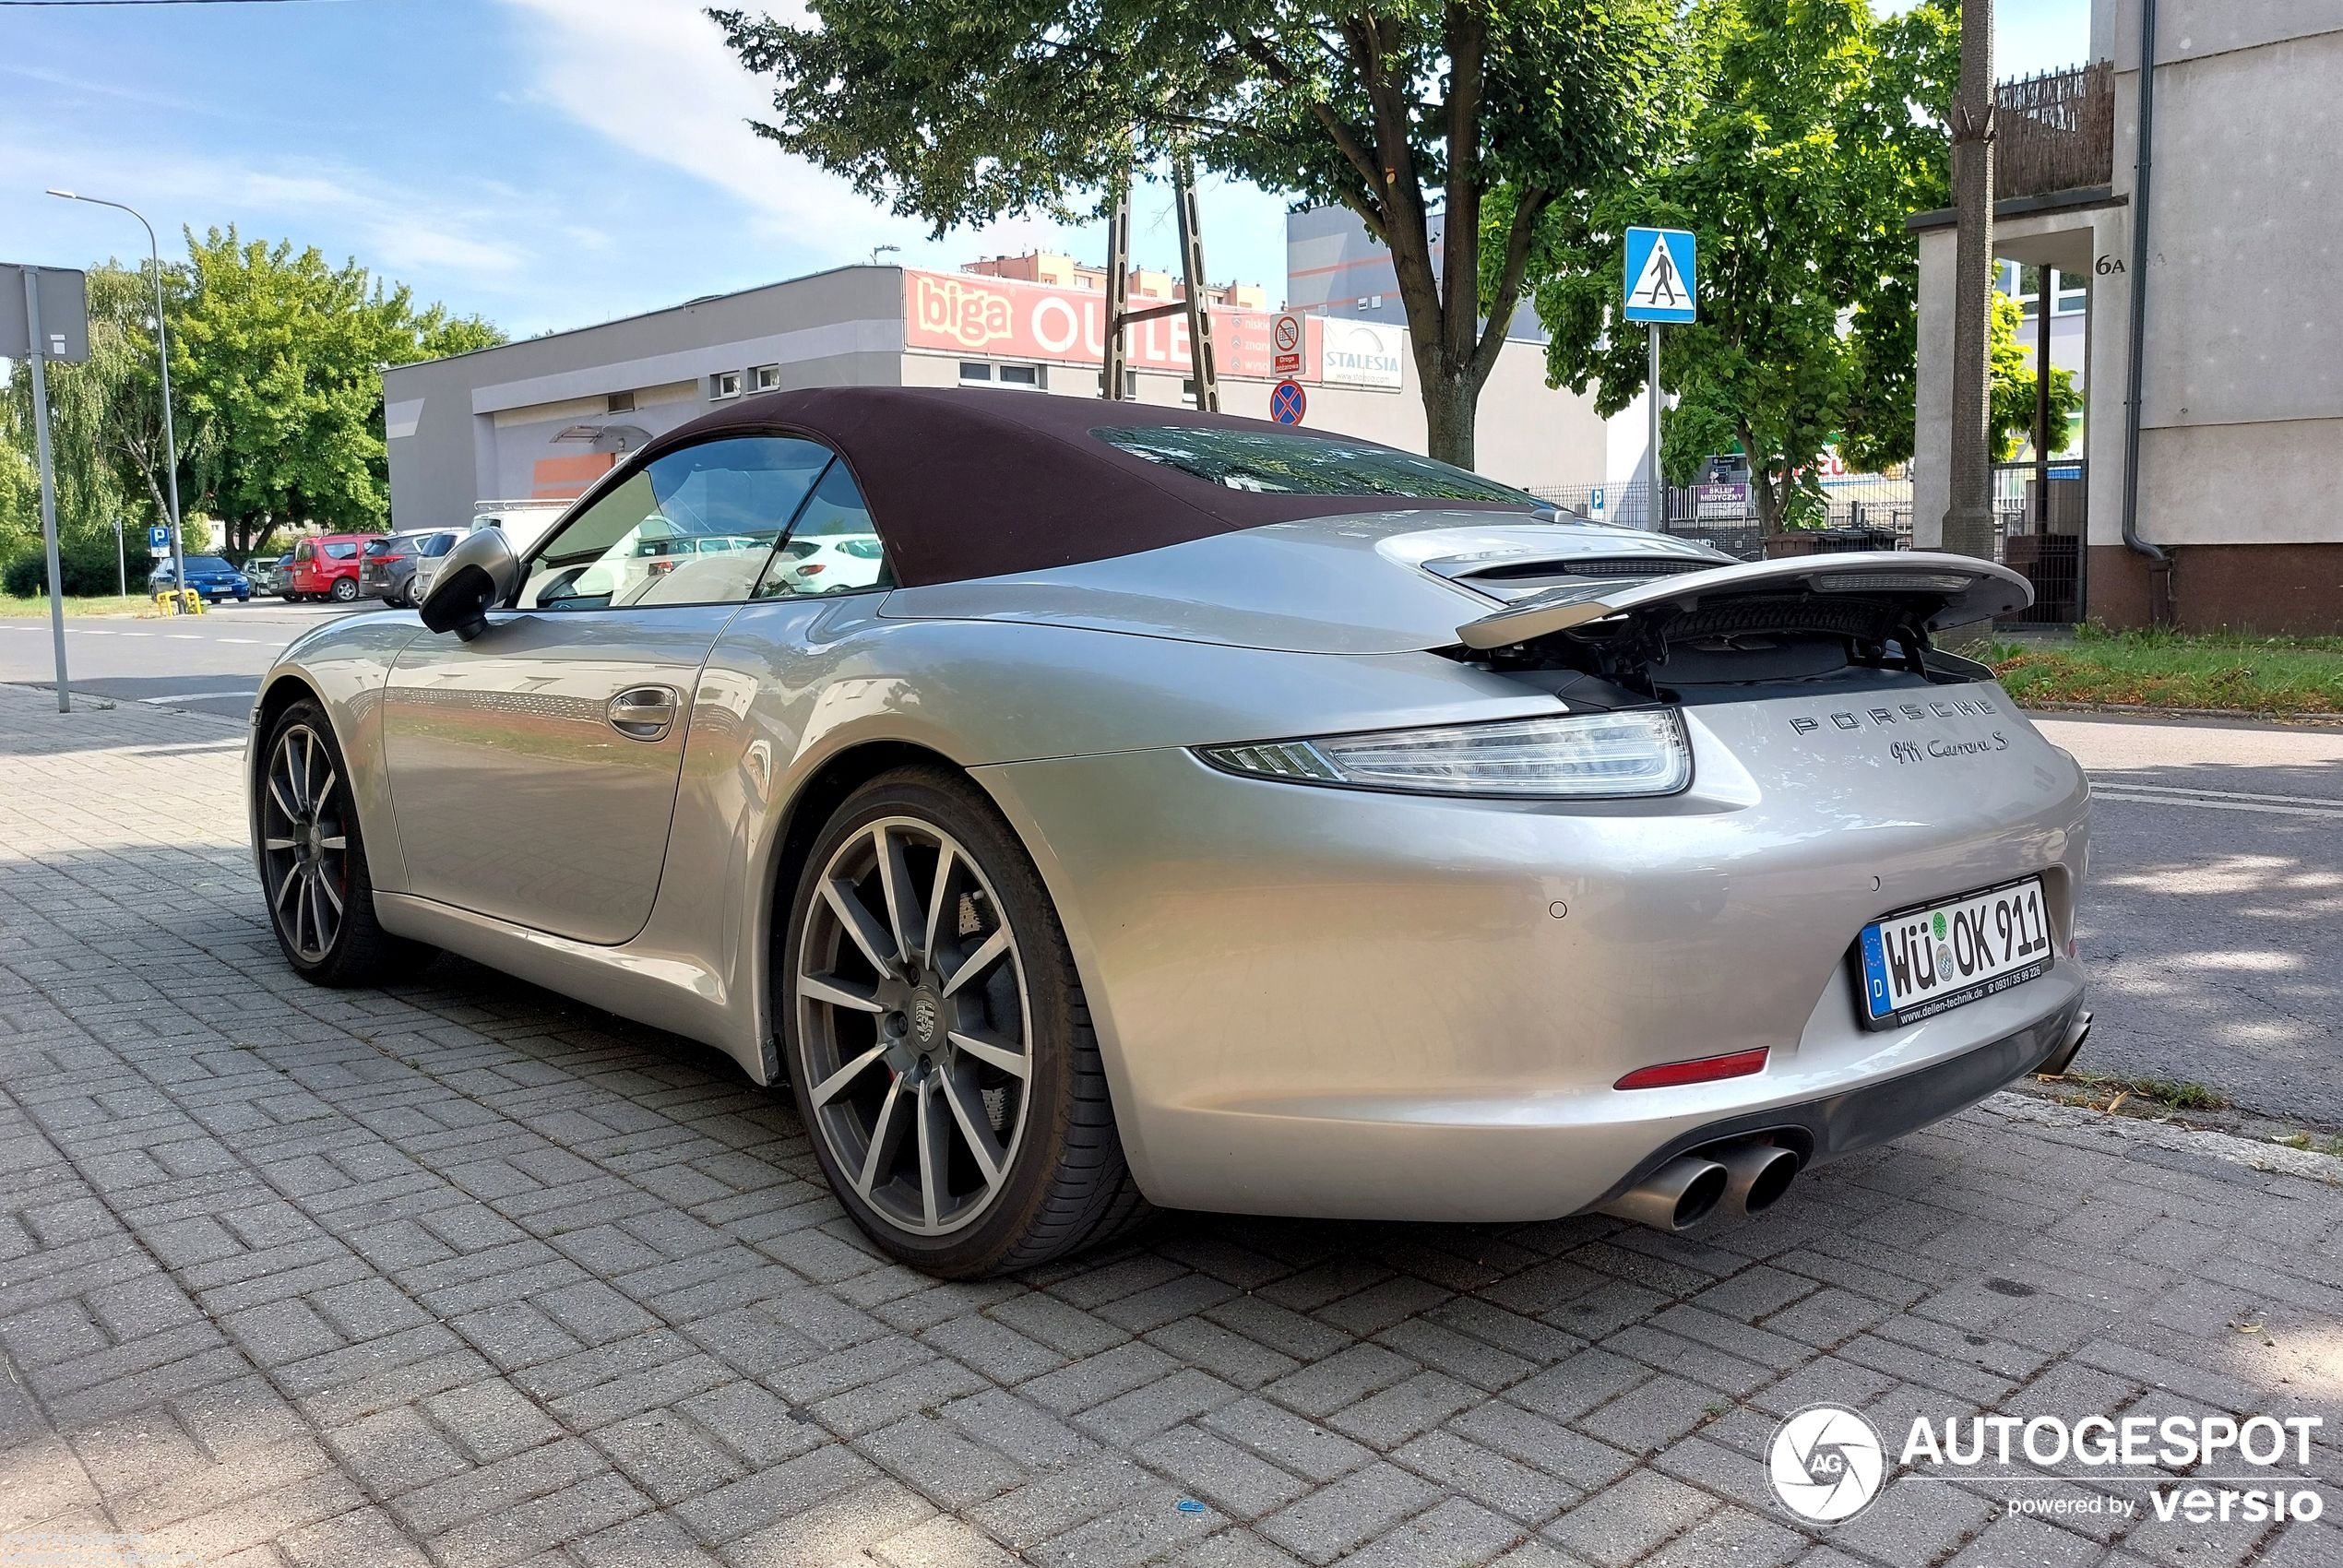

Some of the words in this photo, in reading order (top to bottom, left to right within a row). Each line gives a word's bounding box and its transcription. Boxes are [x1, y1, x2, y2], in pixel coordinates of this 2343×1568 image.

[2096, 255, 2125, 275] 6A
[919, 279, 1012, 345] biga
[1031, 296, 1216, 364] OUTLE
[1326, 351, 1398, 372] STALESIA
[154, 529, 165, 542] P
[1790, 699, 1995, 735] PORSCHE
[1891, 740, 1924, 764] 911
[1927, 739, 1992, 757] Carrera
[1992, 731, 2009, 751] S
[1953, 905, 1996, 977] OK
[1995, 890, 2047, 963] 911
[1873, 979, 1883, 998] D
[1900, 988, 1983, 1025] www.dellen-technik.de
